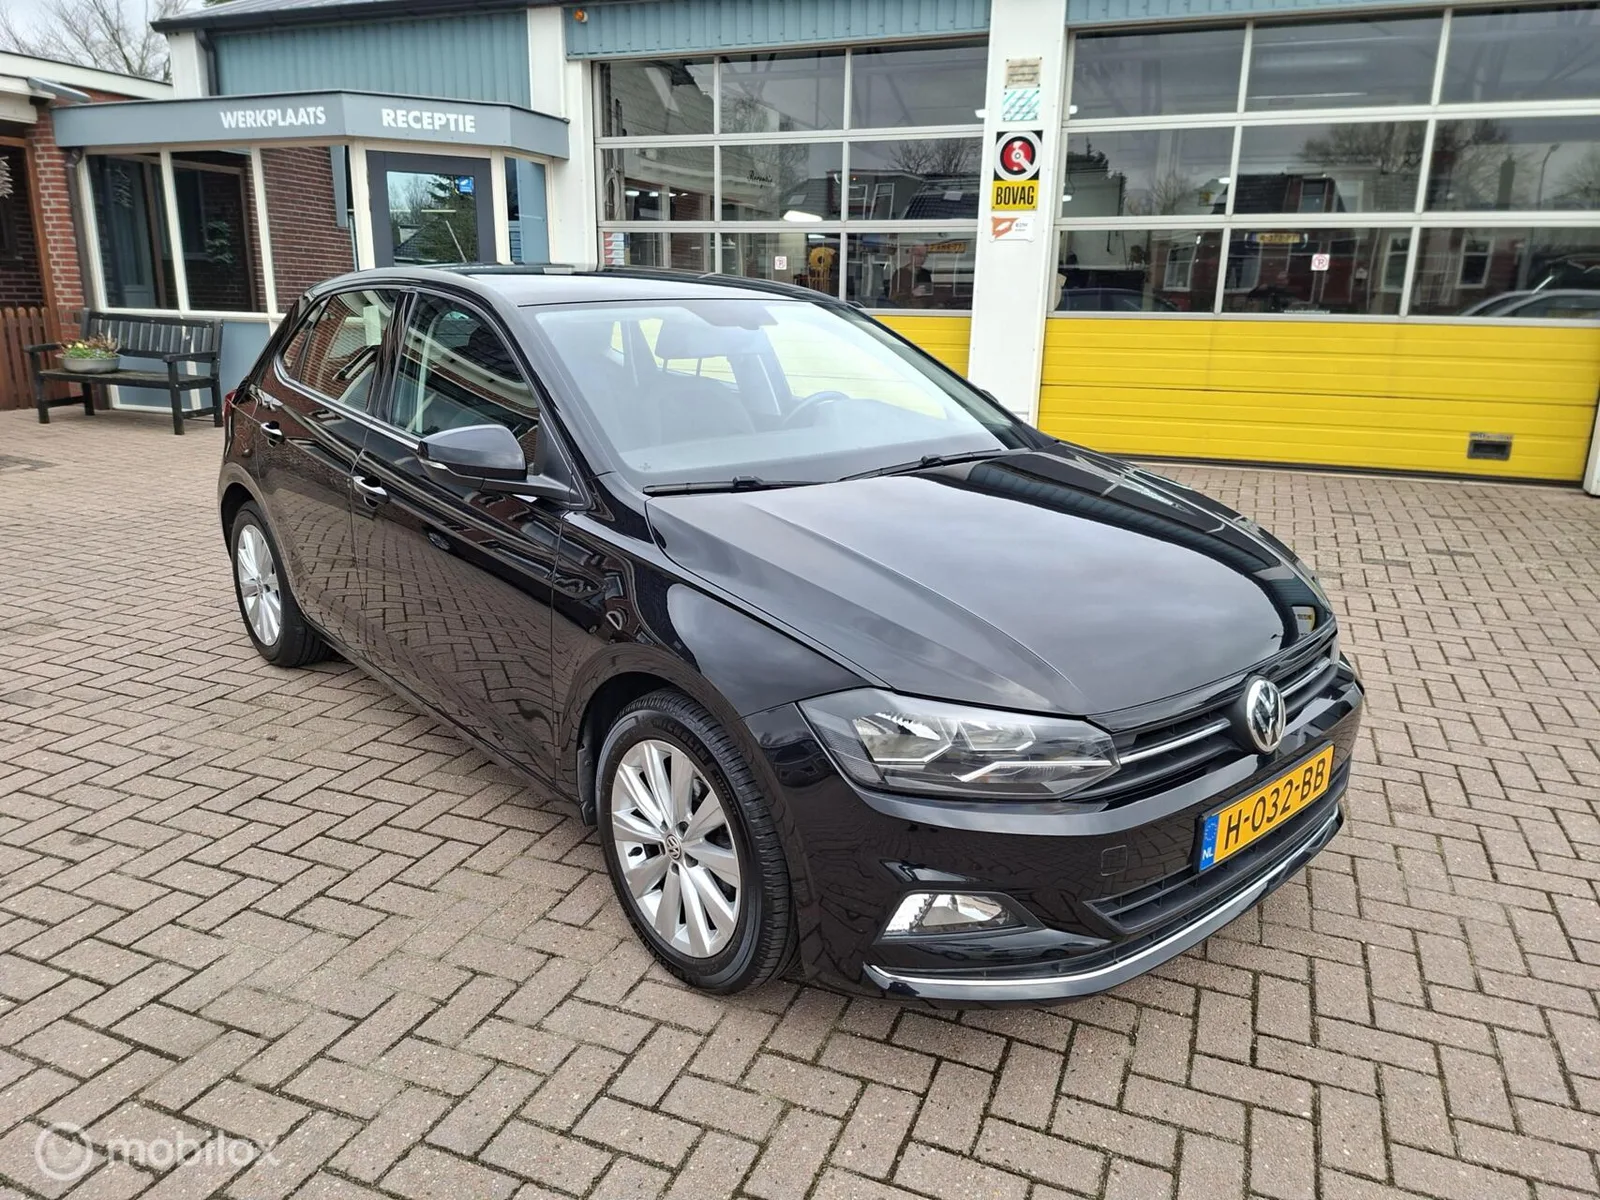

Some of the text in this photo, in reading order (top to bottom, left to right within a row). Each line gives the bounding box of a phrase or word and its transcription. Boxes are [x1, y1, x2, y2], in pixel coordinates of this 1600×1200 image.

[220, 106, 326, 129] WERKPLAATS
[380, 107, 476, 133] RECEPTIE
[995, 185, 1035, 206] BOVAG
[1224, 757, 1326, 850] H-032-BB
[1201, 846, 1214, 860] NL
